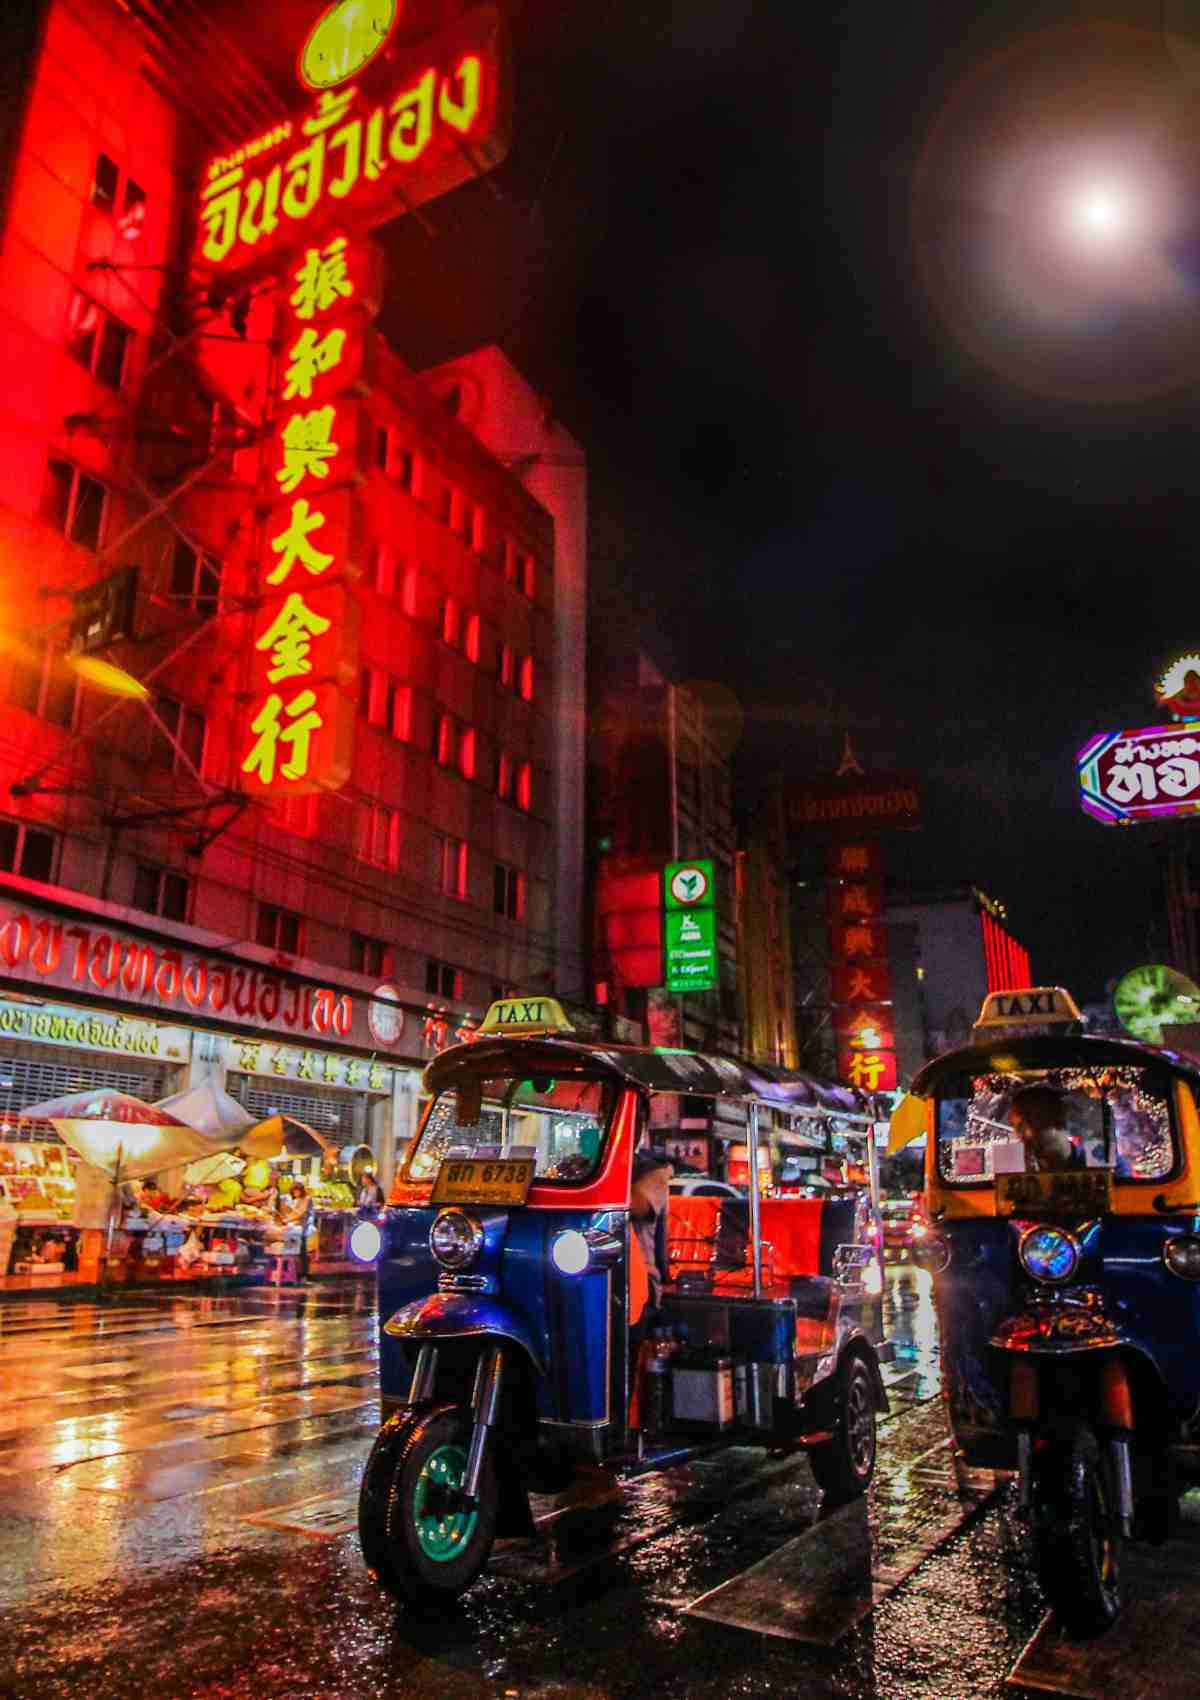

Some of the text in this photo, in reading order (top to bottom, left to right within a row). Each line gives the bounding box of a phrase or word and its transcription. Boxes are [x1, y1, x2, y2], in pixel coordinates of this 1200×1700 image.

[495, 1002, 545, 1023] TAXI
[995, 994, 1056, 1016] TAXI
[481, 1164, 528, 1183] 6738
